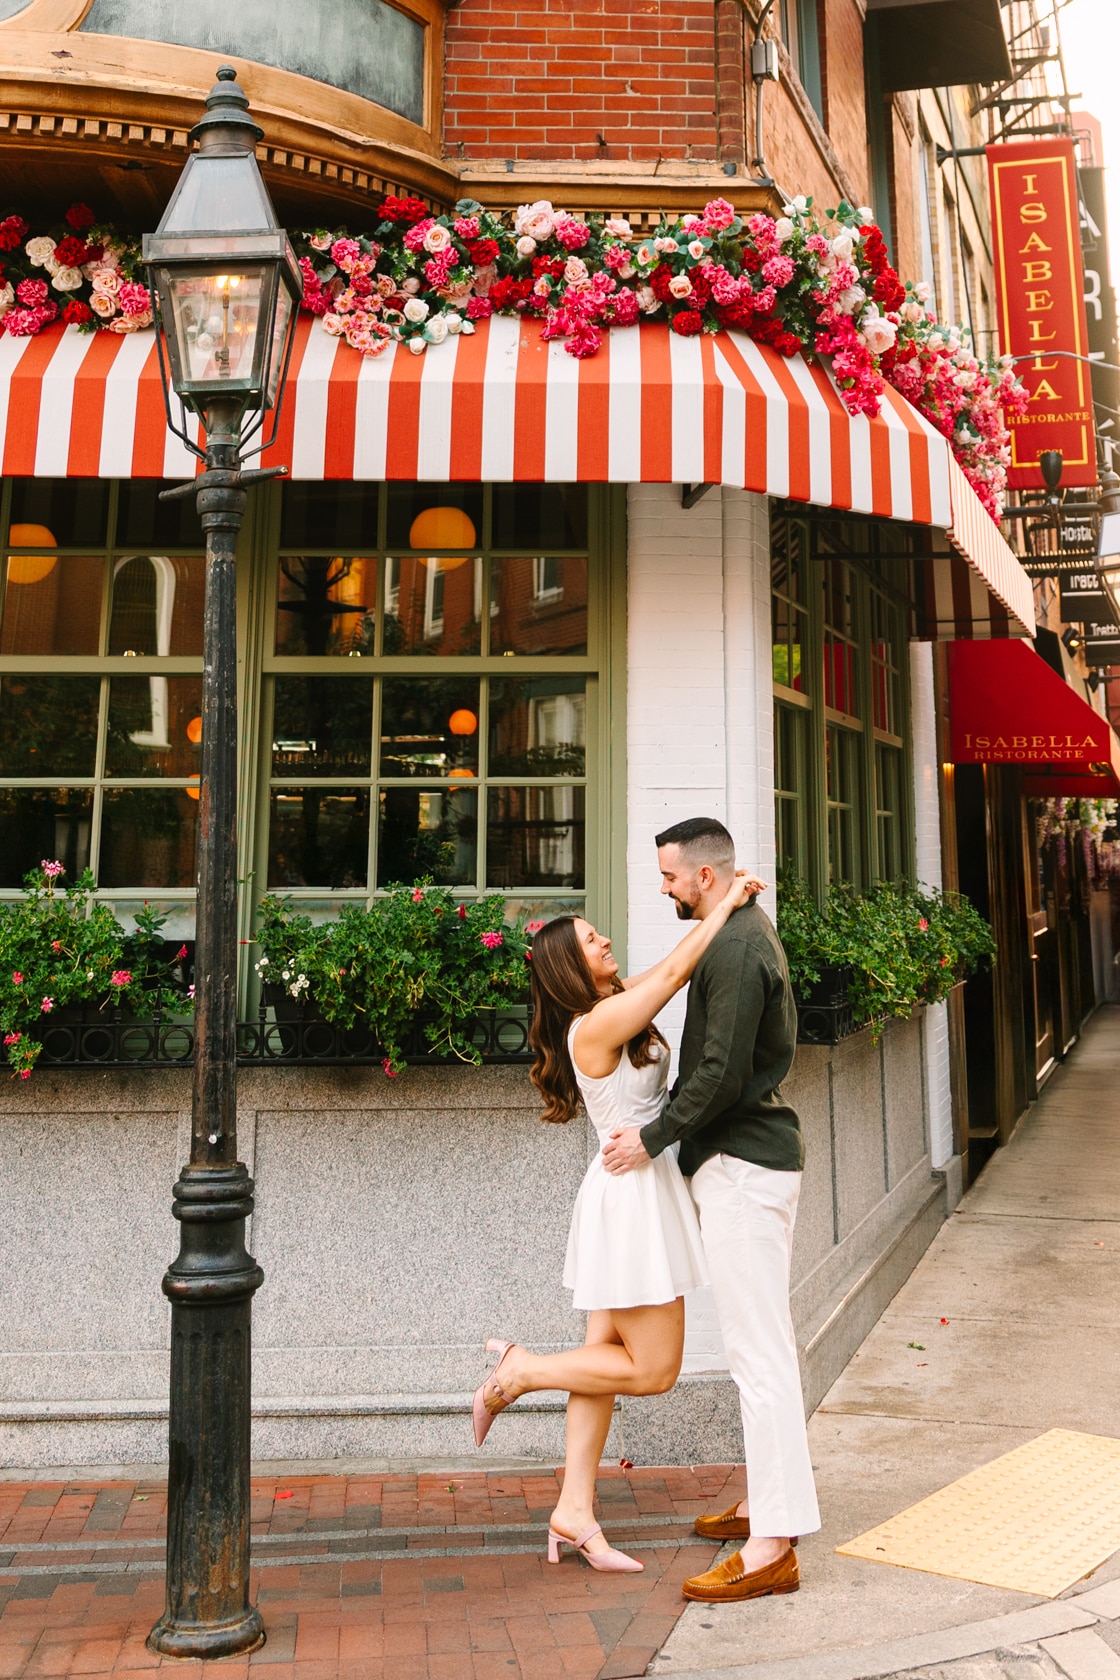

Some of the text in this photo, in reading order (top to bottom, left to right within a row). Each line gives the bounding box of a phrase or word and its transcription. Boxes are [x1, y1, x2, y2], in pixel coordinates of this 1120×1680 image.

[1018, 174, 1062, 401] ISABELLA
[1007, 411, 1091, 425] RISTORANTE
[964, 733, 1099, 748] ISABELLA
[974, 749, 1085, 760] RISTORANTE
